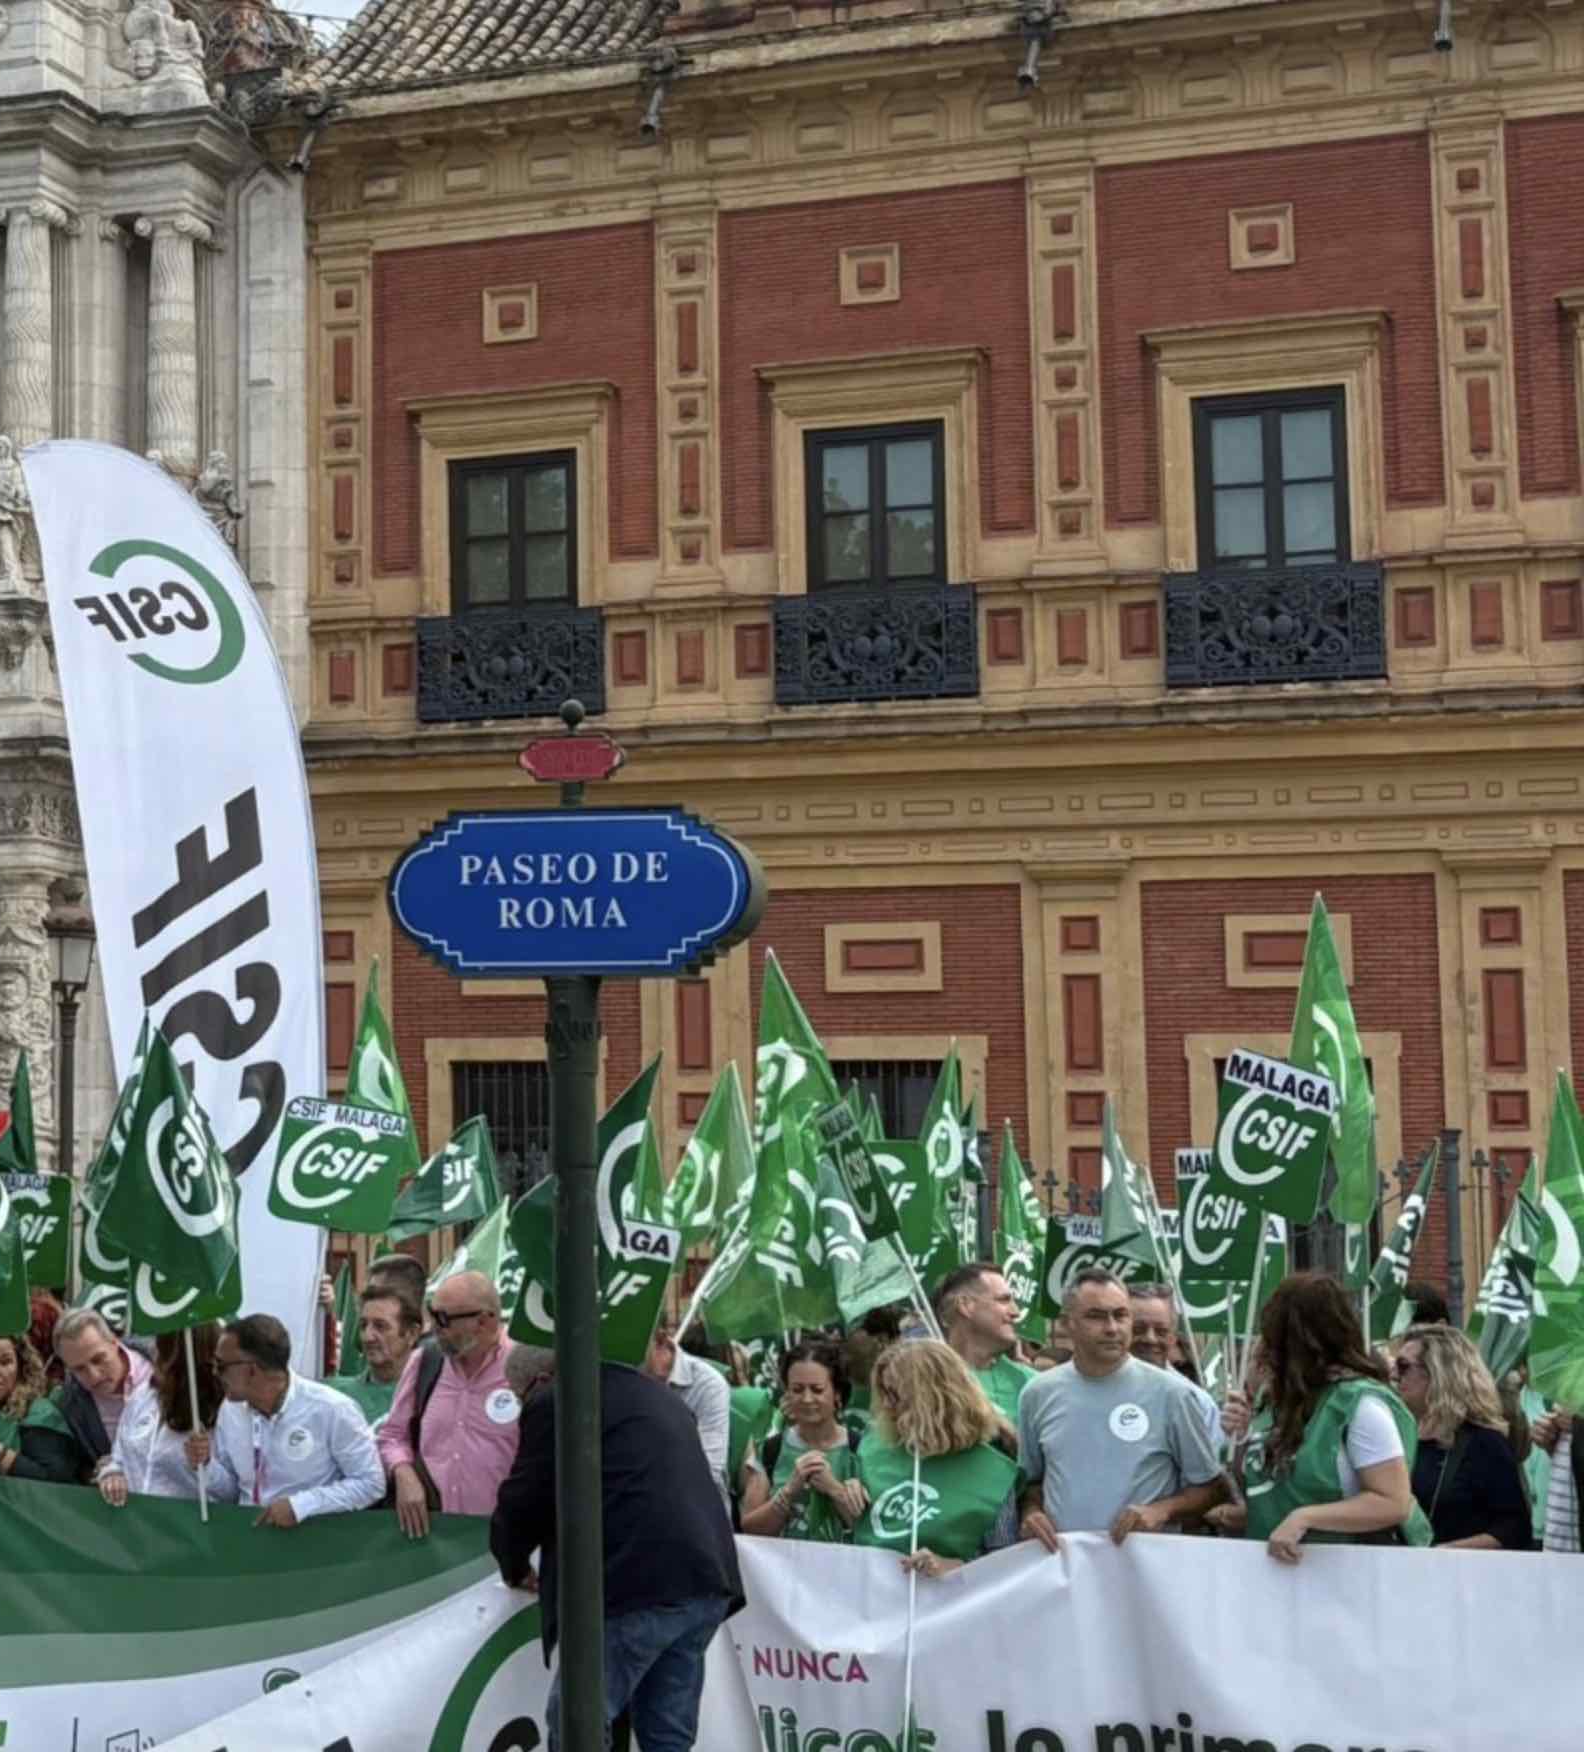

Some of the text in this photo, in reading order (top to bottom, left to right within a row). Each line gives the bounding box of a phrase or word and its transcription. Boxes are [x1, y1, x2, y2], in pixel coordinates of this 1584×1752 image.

[459, 851, 669, 885] PASEO DE
[498, 897, 628, 929] ROMA
[1238, 1108, 1317, 1161] CSIF
[300, 1143, 390, 1184] CSIF
[443, 1158, 477, 1185] SIF
[19, 1215, 59, 1244] SIF
[753, 1646, 869, 1683] NUNCA
